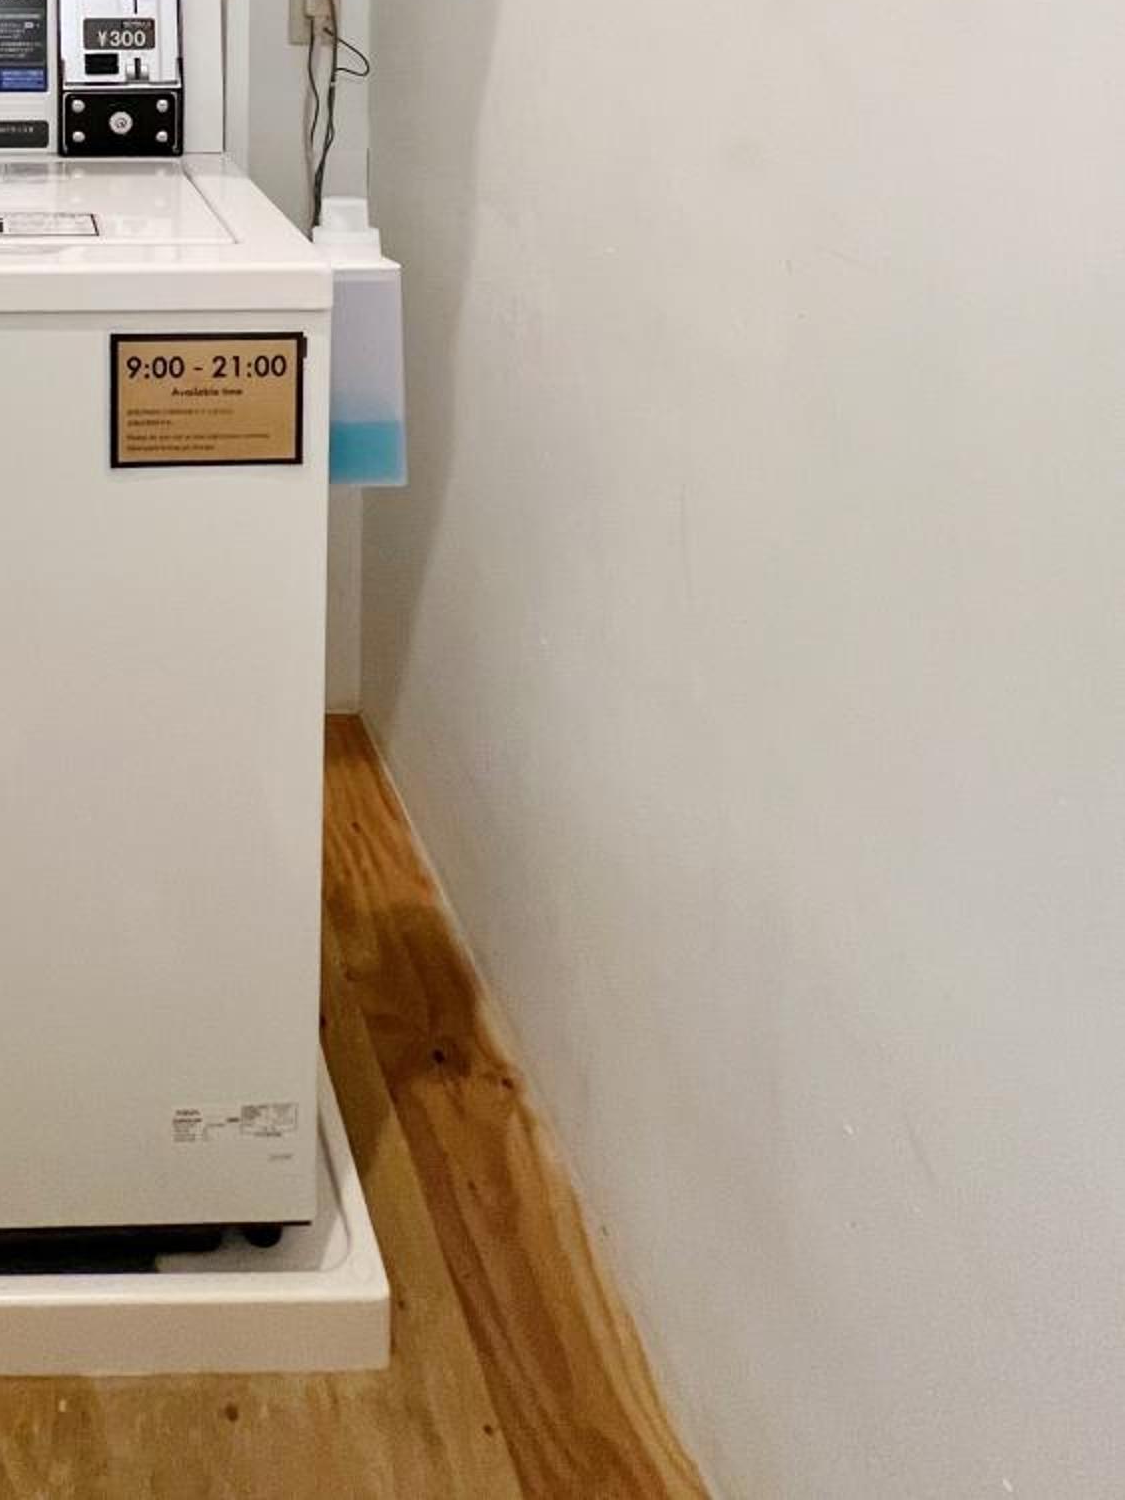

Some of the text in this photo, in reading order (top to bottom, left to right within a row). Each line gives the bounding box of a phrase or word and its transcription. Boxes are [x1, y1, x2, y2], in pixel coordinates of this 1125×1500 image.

[98, 30, 146, 48] ¥300
[126, 355, 185, 379] 9:00
[212, 354, 287, 378] 21:00
[170, 386, 244, 397] Available time
